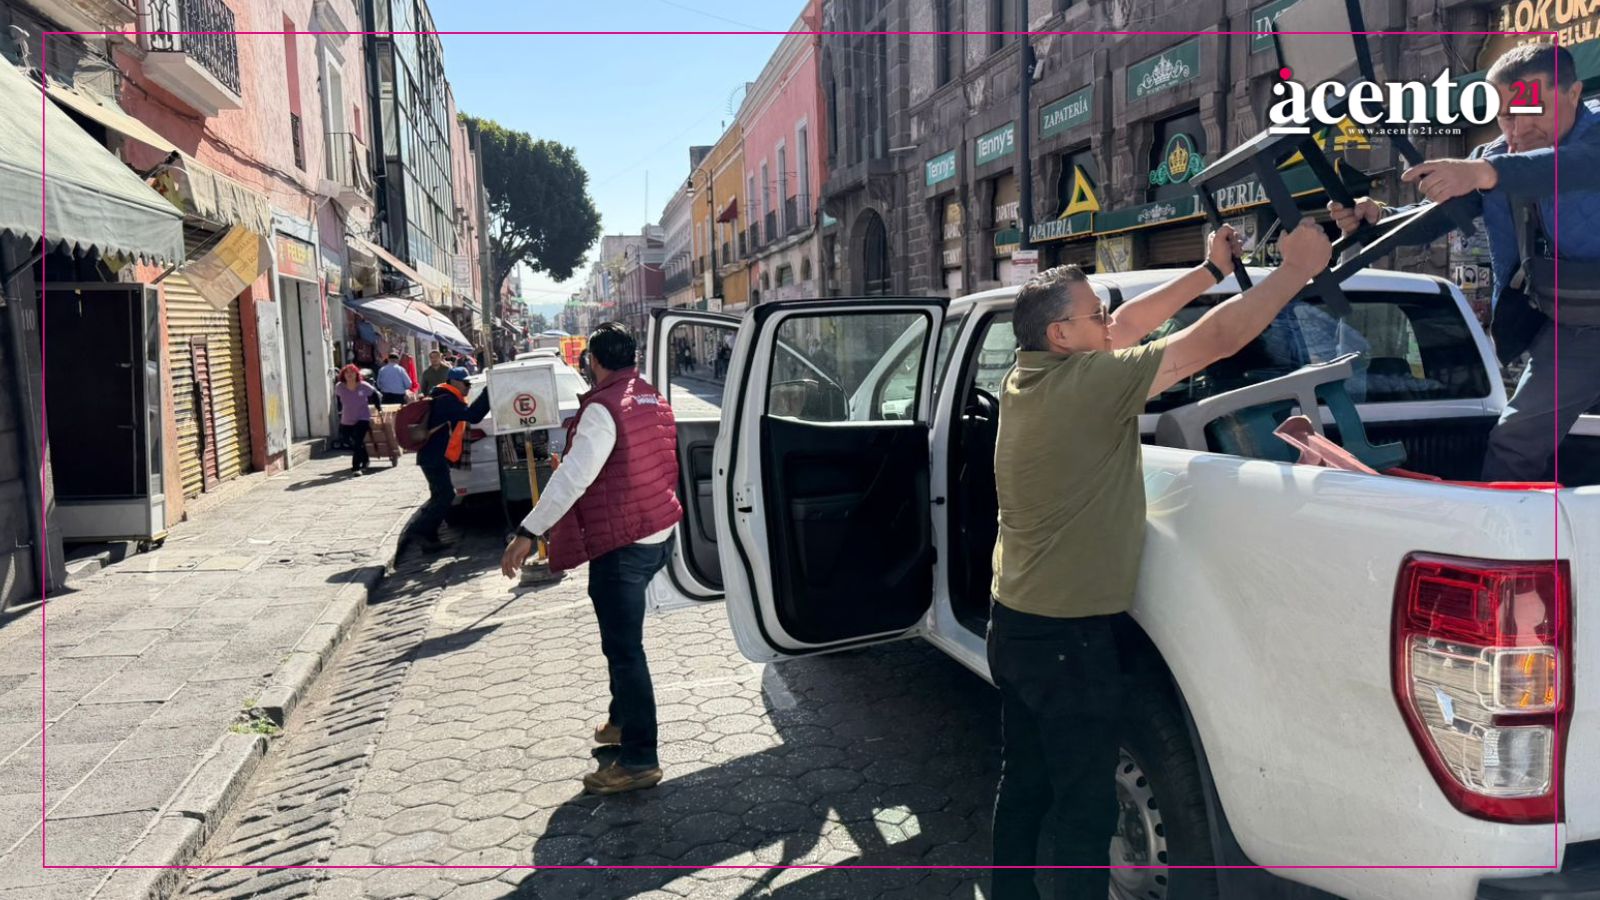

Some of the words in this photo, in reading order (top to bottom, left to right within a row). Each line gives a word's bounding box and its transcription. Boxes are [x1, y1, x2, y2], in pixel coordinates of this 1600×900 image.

[1550, 19, 1600, 47] ELUL
[1043, 96, 1088, 129] ZAPATERÍA
[977, 128, 1014, 158] Tenny's
[1192, 181, 1269, 215] IPERIA
[519, 416, 537, 425] NO
